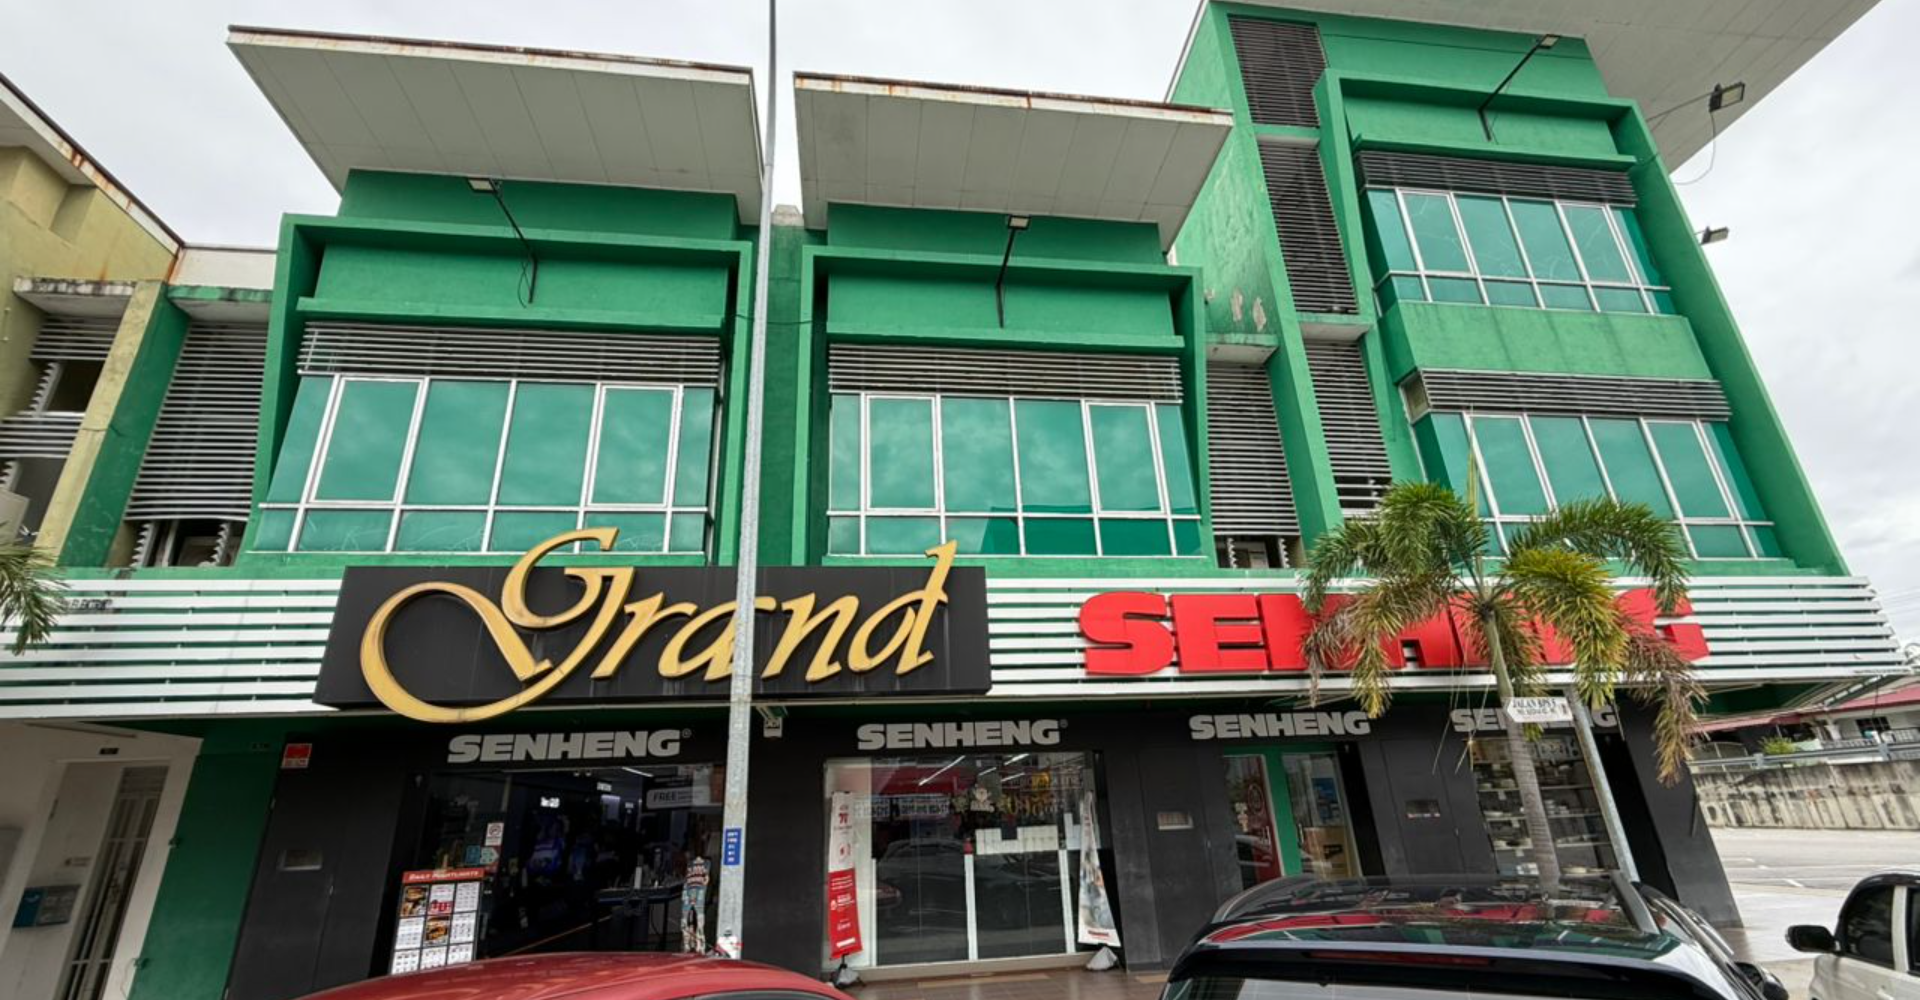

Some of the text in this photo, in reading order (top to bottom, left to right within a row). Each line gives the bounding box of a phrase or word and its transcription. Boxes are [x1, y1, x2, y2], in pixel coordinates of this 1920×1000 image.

[360, 527, 957, 723] Grand
[857, 719, 1060, 749] SENHENG
[1189, 711, 1371, 739] SENHENG
[447, 730, 680, 763] SENHENG
